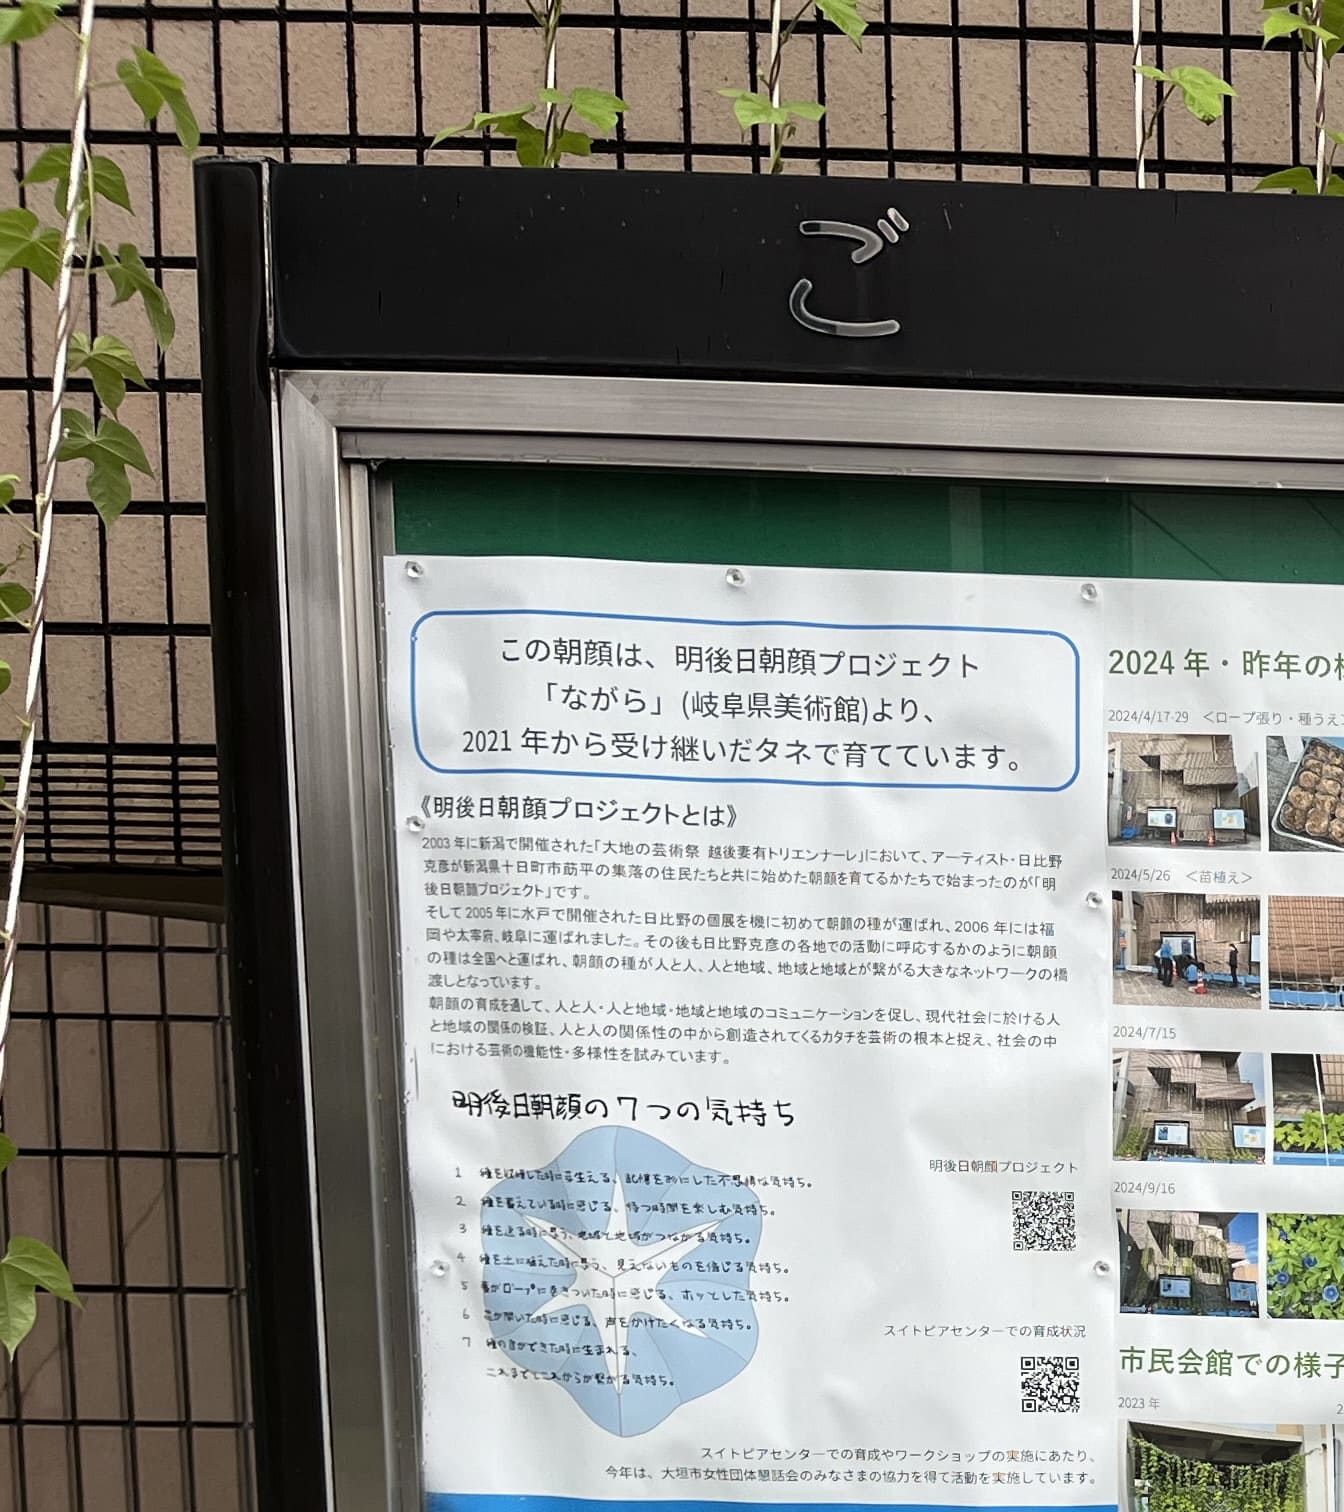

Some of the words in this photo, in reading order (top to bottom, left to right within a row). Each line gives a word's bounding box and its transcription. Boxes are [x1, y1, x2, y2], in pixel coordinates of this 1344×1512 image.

[500, 638, 980, 677] この朝顔は、明後日朝顔プロジェクト
[545, 682, 935, 724] 「ながら」(岐阜県美術館)より、
[1107, 709, 1189, 724] 2024/4/17-29
[421, 795, 737, 828] 《明後日朝顔プロジェクトとは》
[1111, 868, 1171, 882] 2024/5/26
[428, 974, 541, 990] 渡しとなっています。
[1113, 1026, 1177, 1041] 2024/7/15
[929, 1159, 1078, 1174] 明後日朝顔プロジェクト
[1113, 1180, 1176, 1196] 2024/9/16
[884, 1324, 1086, 1338] スイトピアセンターでの育成状況
